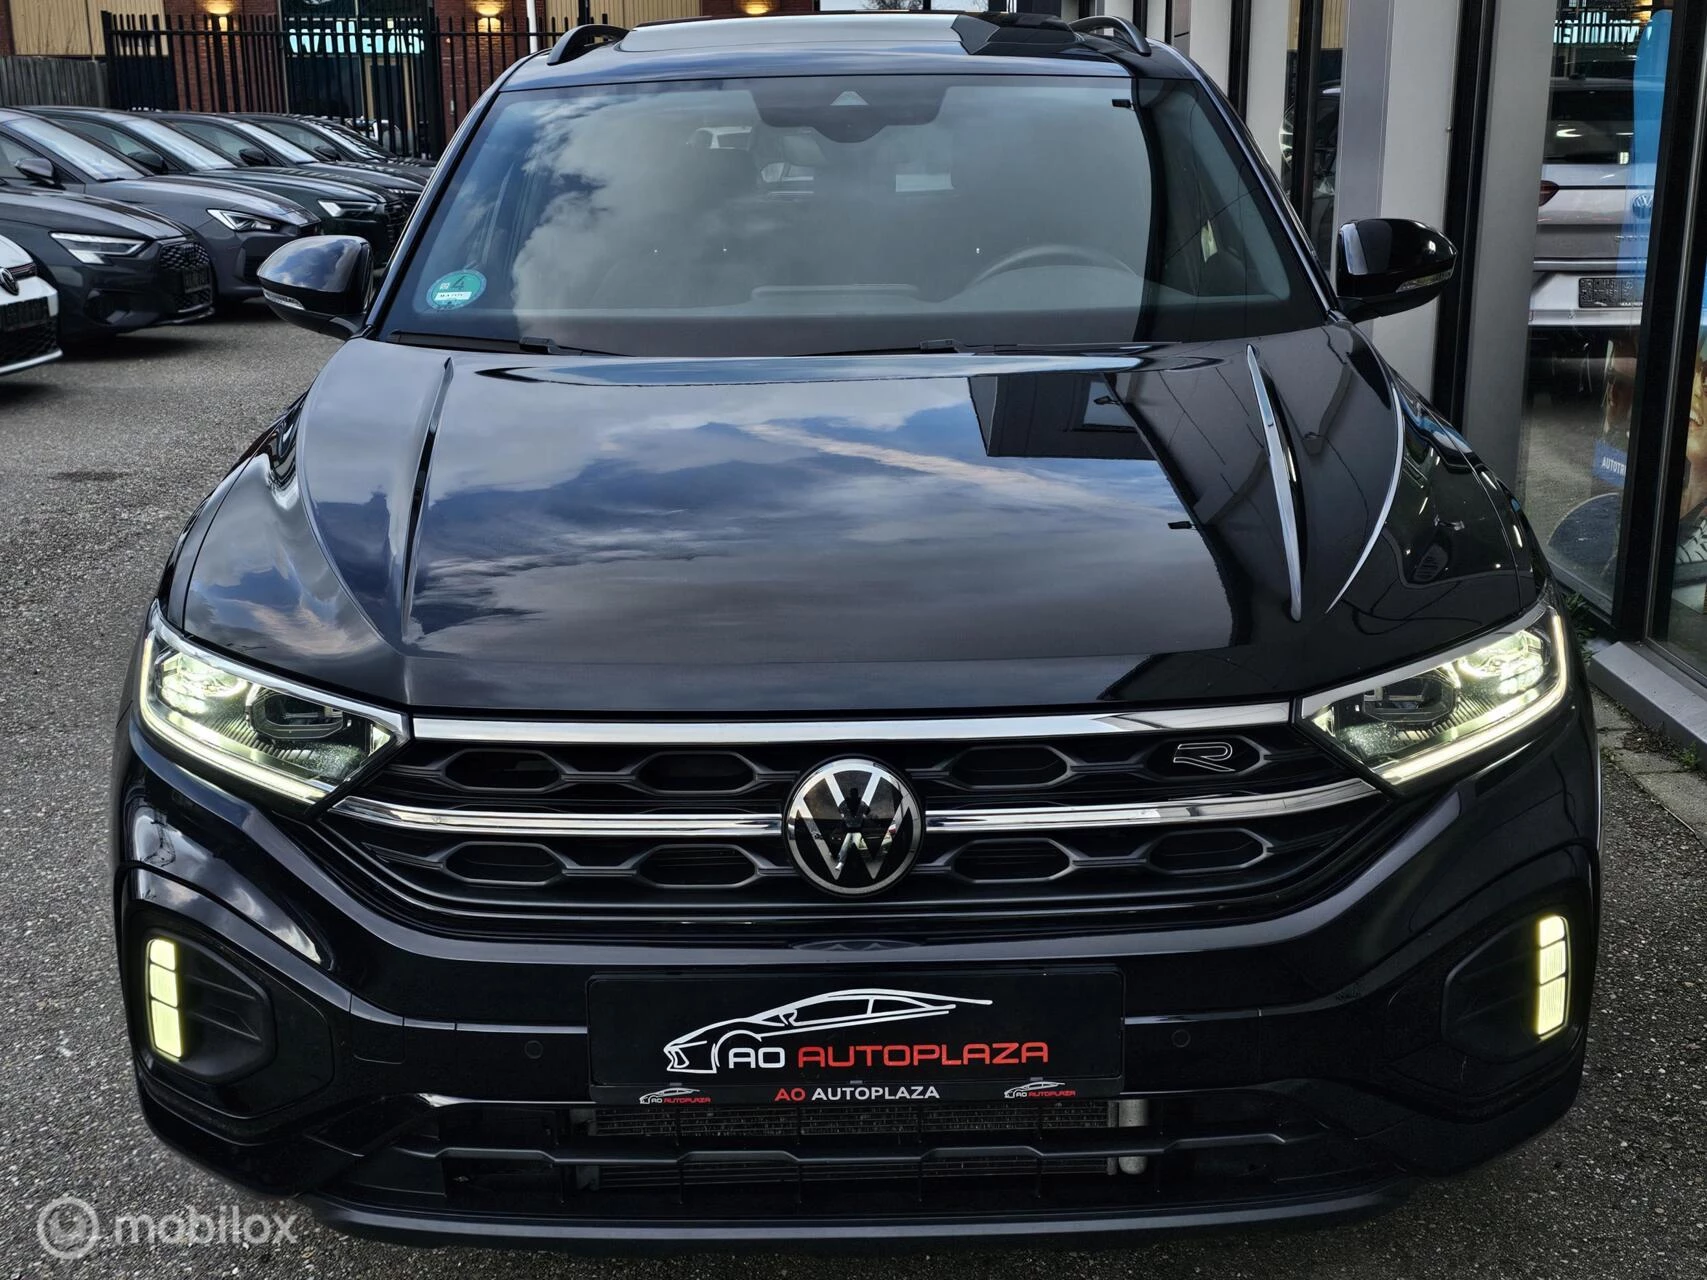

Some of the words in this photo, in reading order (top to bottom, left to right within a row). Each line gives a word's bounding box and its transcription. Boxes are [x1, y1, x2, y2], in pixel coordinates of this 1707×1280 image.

[728, 1047, 785, 1069] AO
[798, 1042, 1049, 1068] AUTOPLAZA
[774, 1087, 806, 1102] AO
[811, 1086, 940, 1101] AUTOPLAZA
